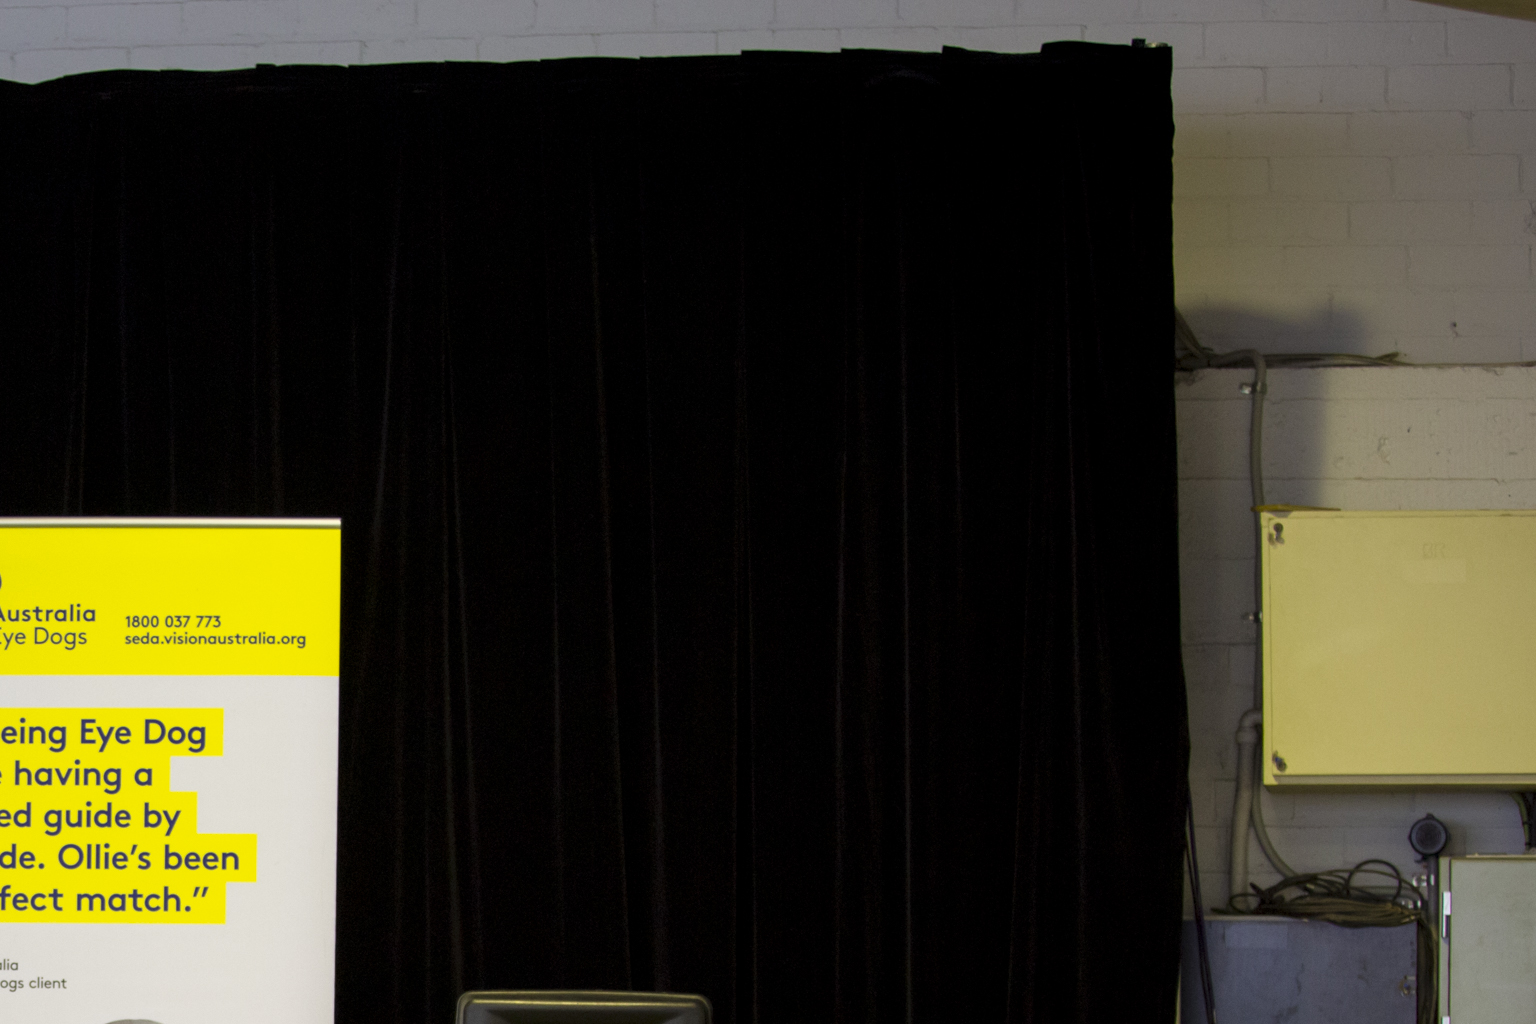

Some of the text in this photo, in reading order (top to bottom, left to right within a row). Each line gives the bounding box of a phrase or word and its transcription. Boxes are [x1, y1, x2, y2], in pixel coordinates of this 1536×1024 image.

[125, 615, 222, 628] 1800 037 773
[34, 626, 87, 651] Dogs
[125, 631, 306, 649] seda.visionaustralia.org
[80, 718, 132, 753] Eye
[144, 718, 206, 753] Dog
[14, 759, 122, 795] having
[134, 768, 153, 787] a
[44, 801, 131, 837] guide
[144, 802, 181, 837] by
[164, 844, 239, 871] been
[28, 976, 67, 990] client
